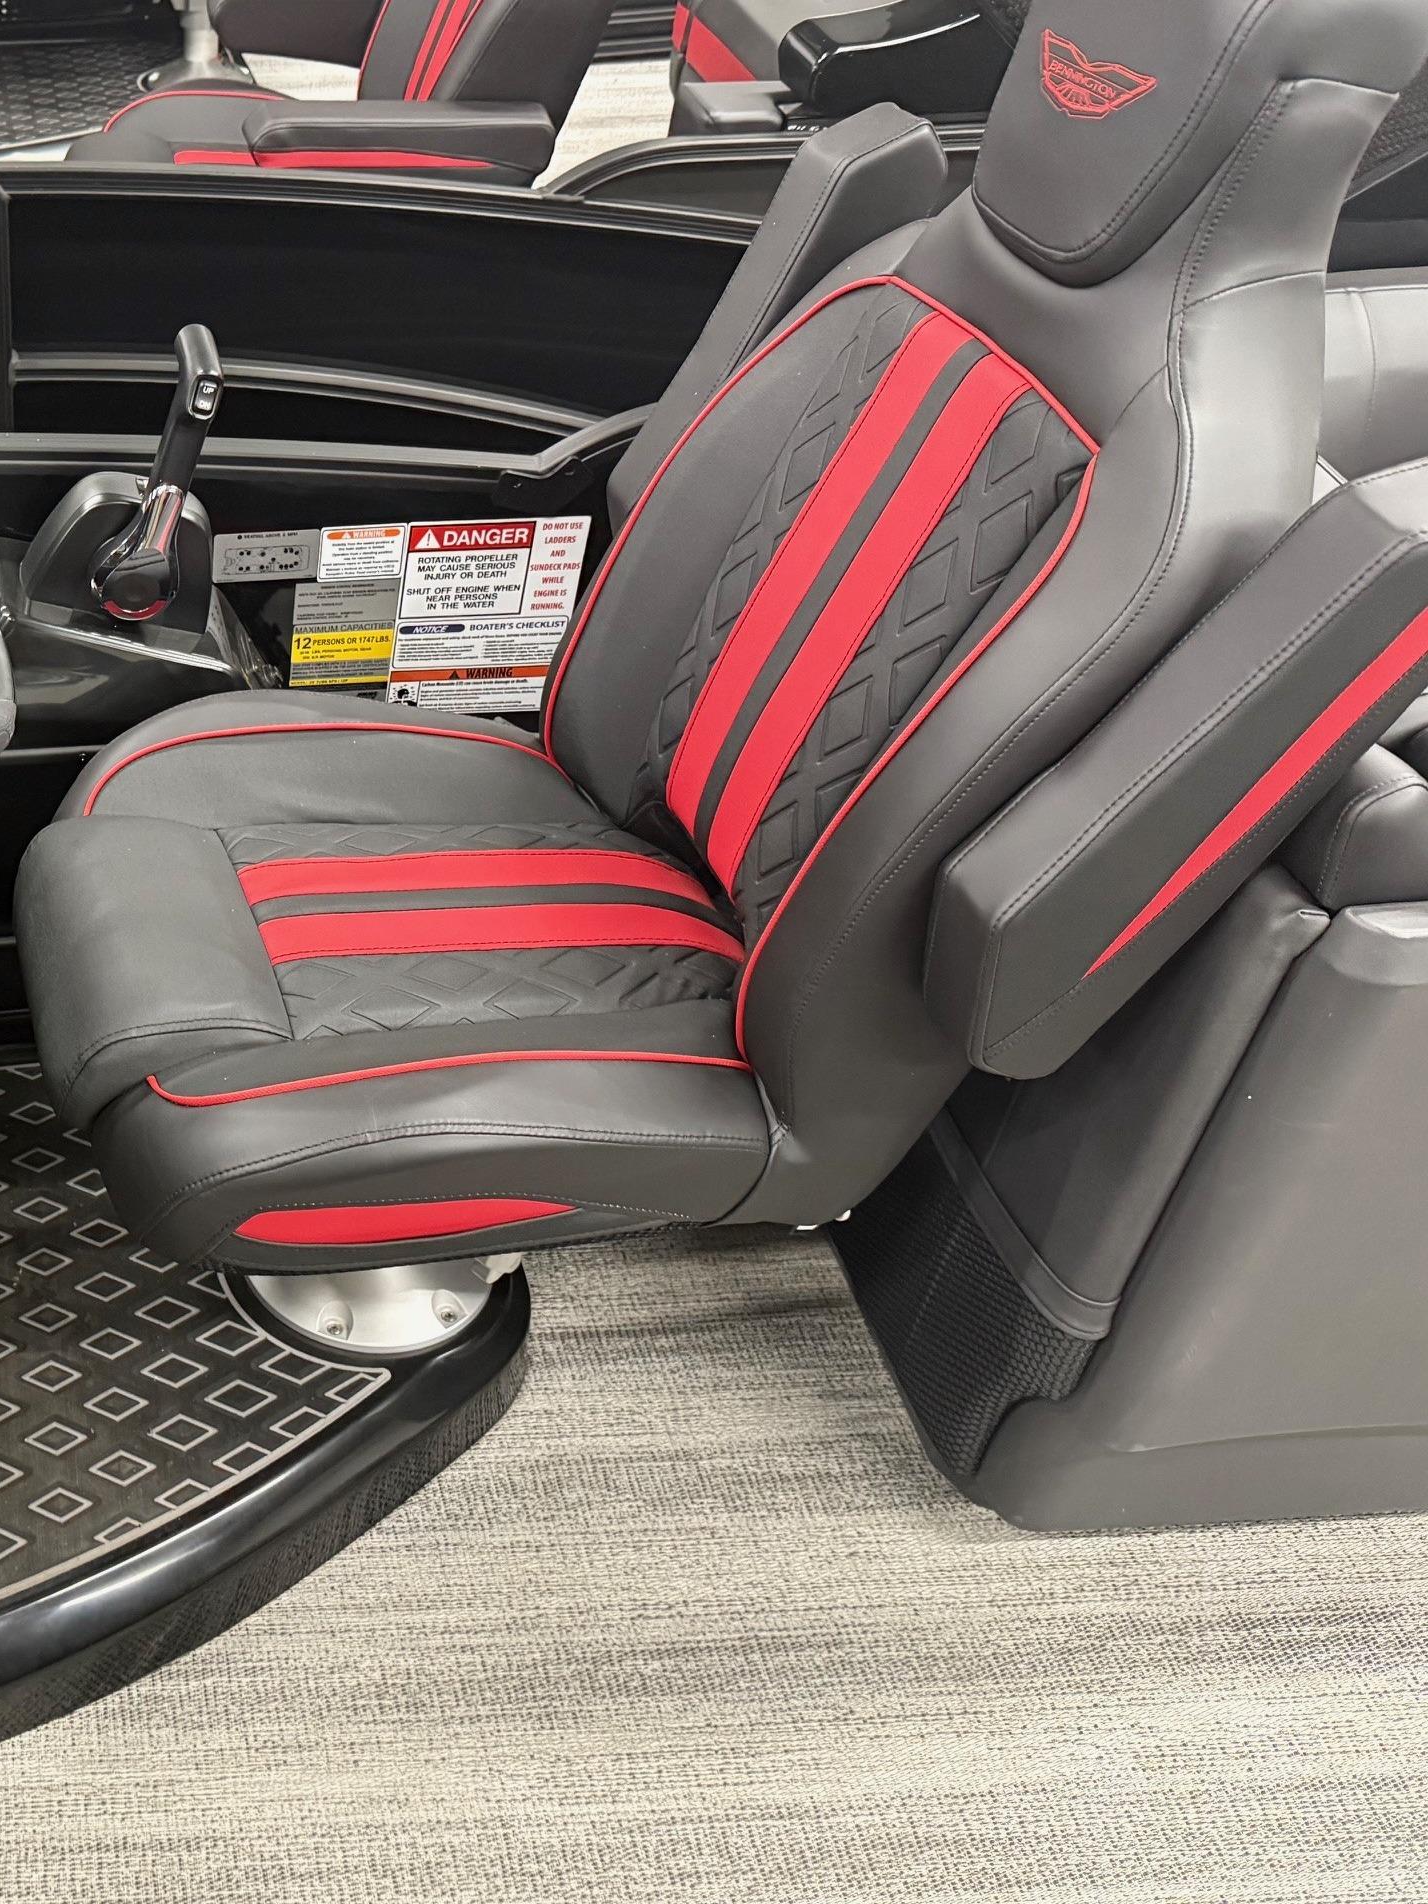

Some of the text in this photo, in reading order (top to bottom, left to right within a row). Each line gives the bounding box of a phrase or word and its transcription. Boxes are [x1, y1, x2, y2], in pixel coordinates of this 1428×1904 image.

[1049, 59, 1116, 99] BENNINGTON
[353, 530, 385, 538] WARNING
[443, 528, 530, 546] DANGER
[417, 554, 518, 564] ROTATING PROPELLER
[440, 563, 471, 571] CAUSE
[475, 562, 516, 570] SERIOUS
[530, 563, 562, 572] SUNDECK
[424, 572, 458, 581] INJURY
[530, 602, 564, 610] RUNNING.
[295, 622, 393, 634] MAXIMUM CAPACITIES
[469, 621, 567, 632] BOATER'S CHECKLIST
[294, 638, 312, 649] 12
[466, 668, 513, 678] WARNING
